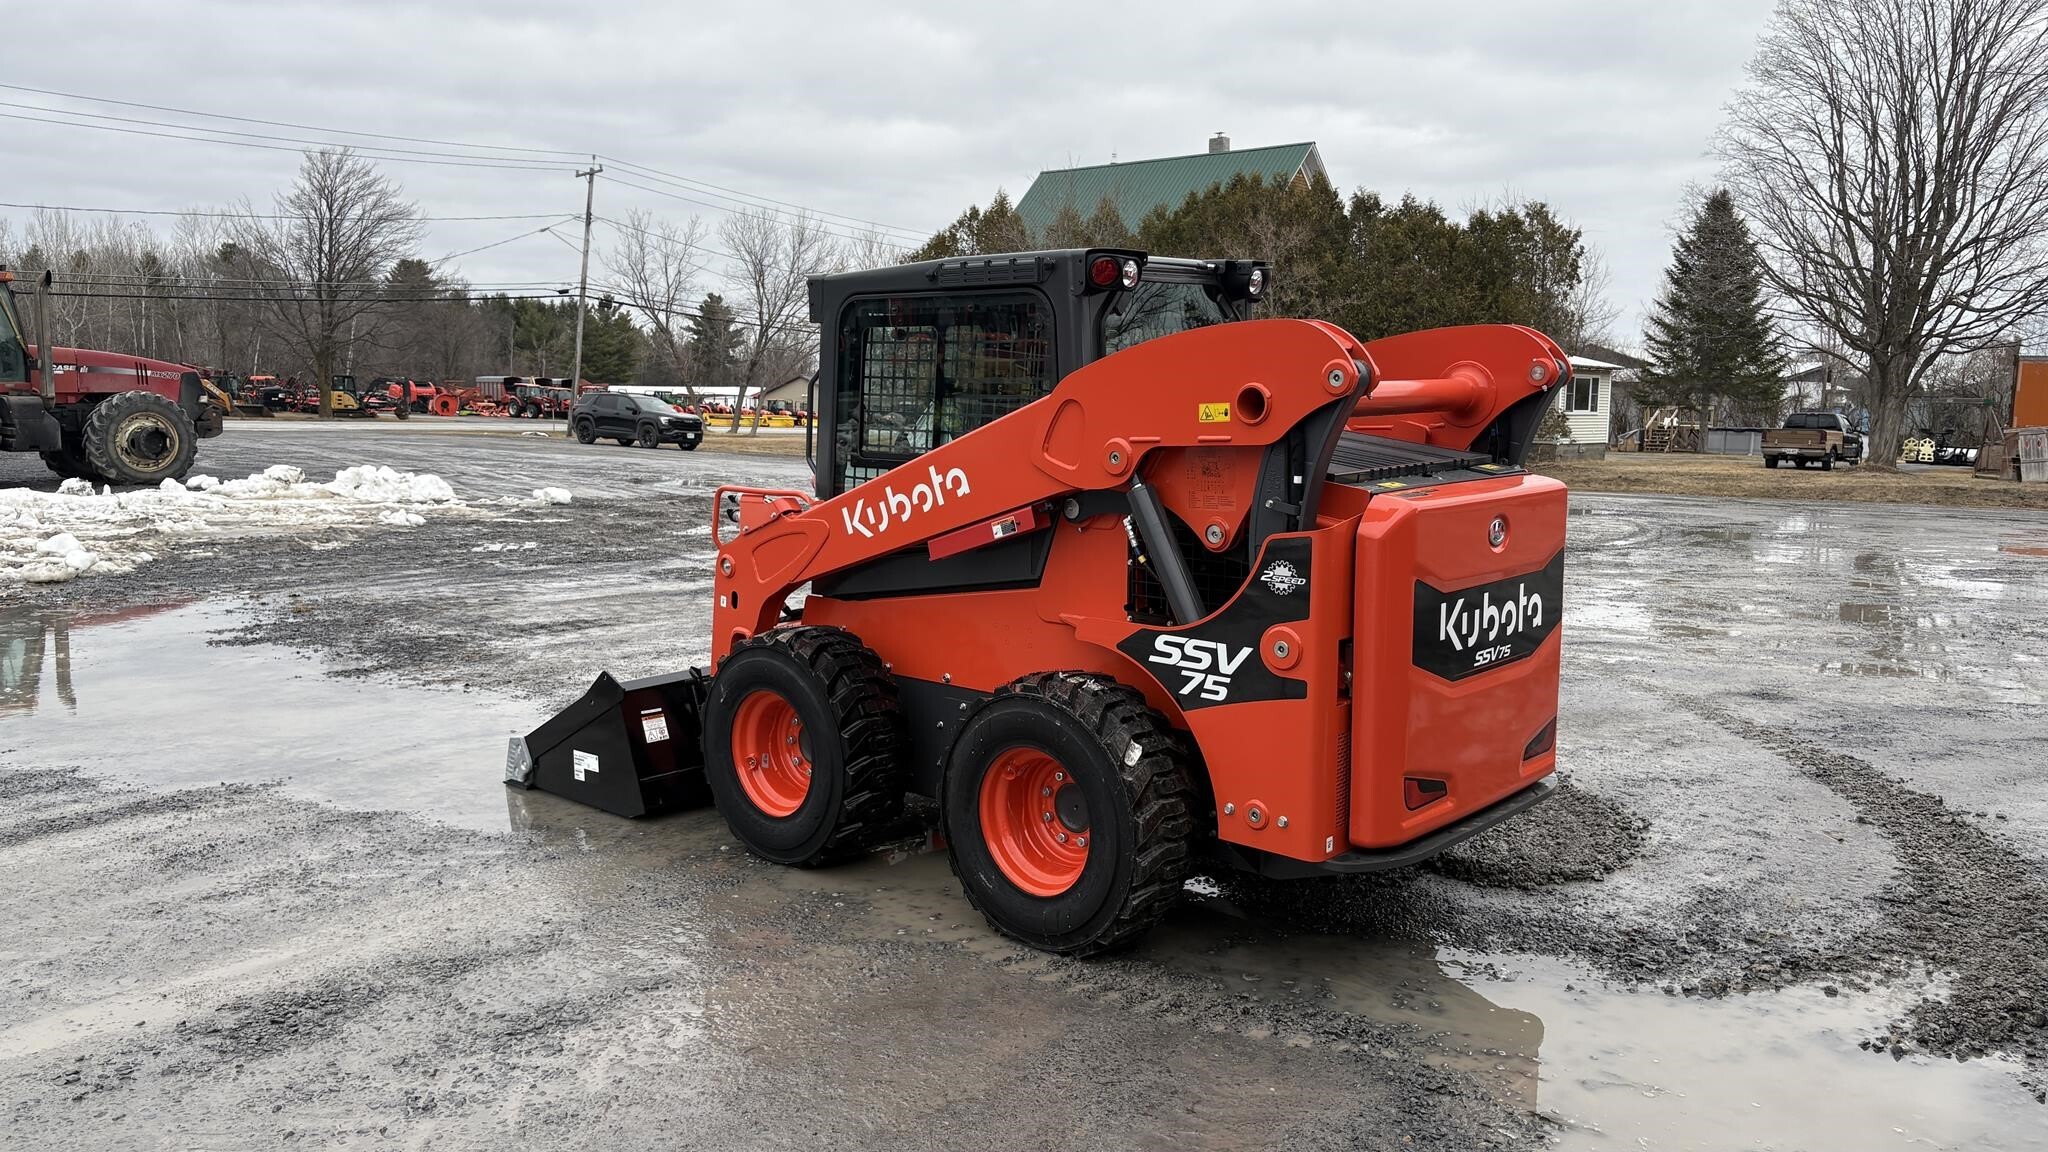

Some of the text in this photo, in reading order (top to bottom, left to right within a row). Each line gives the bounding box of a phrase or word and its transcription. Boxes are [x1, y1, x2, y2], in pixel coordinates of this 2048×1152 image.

[841, 465, 971, 539] Kubota
[1439, 583, 1543, 651] Kubota
[1148, 633, 1254, 676] SSV
[1178, 669, 1231, 702] 75
